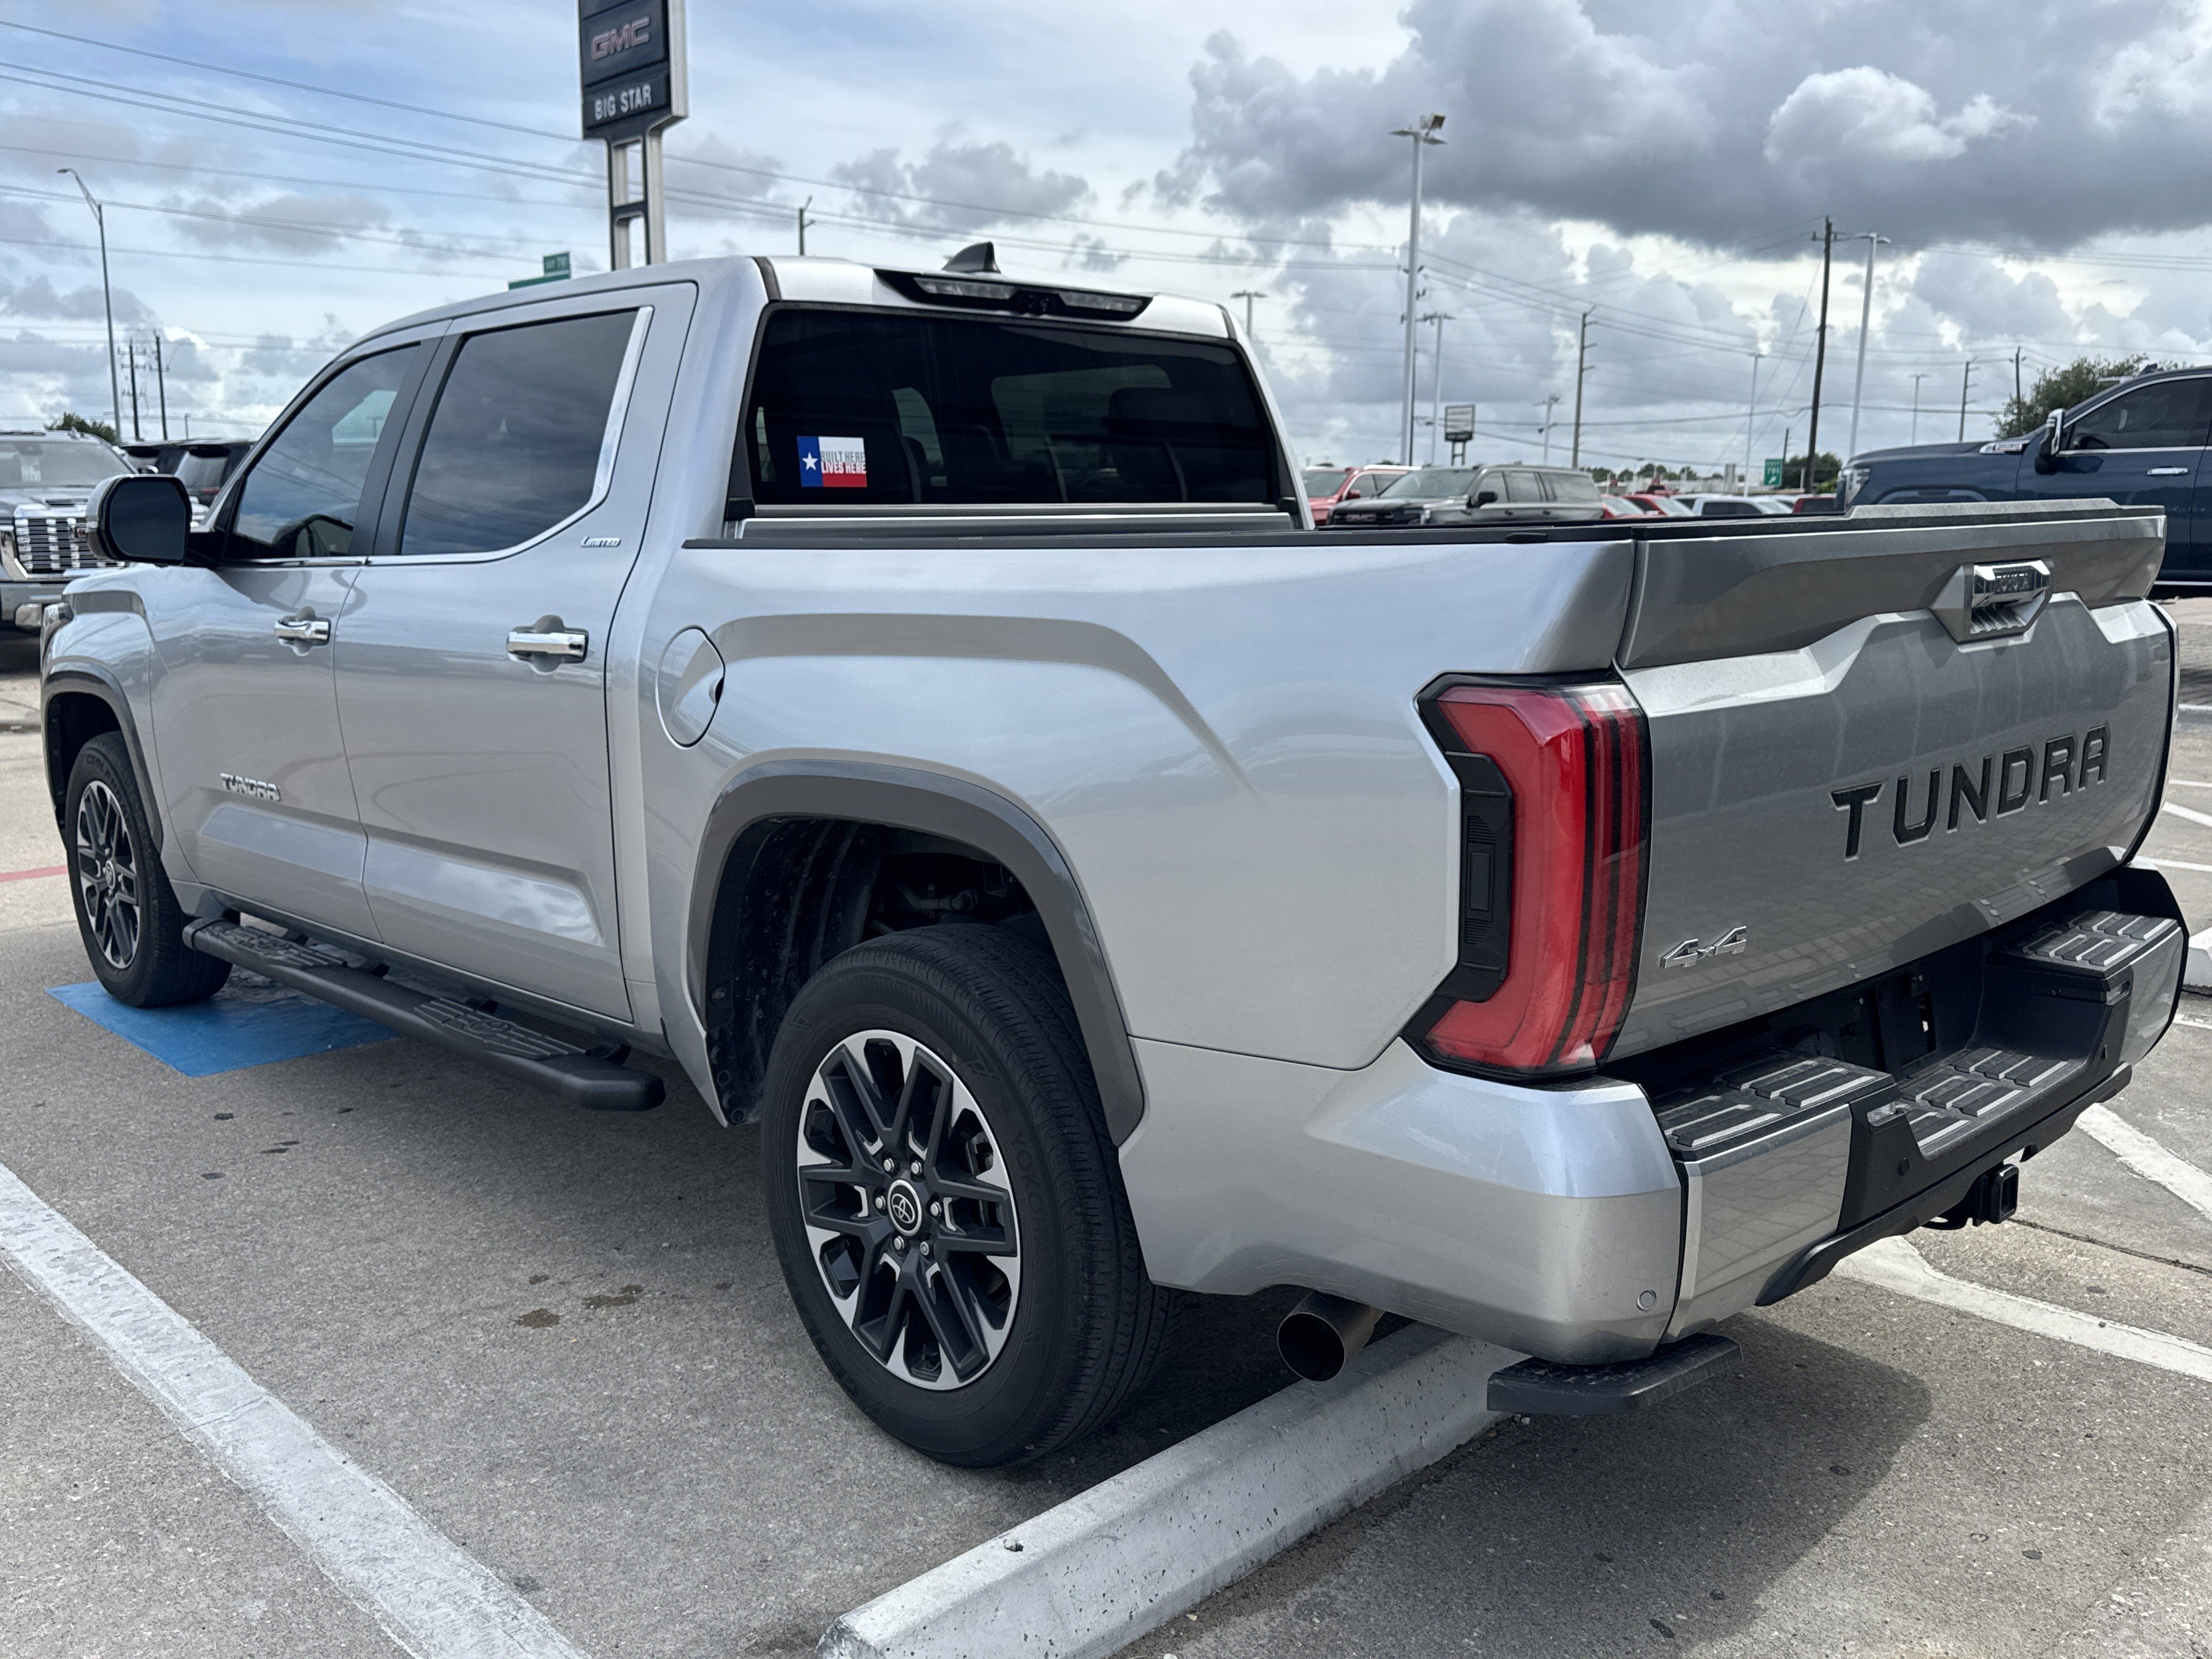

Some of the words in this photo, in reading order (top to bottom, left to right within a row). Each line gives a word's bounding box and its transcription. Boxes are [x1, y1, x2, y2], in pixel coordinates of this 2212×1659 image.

[591, 16, 651, 60] GMC
[594, 95, 616, 120] BIG
[620, 83, 652, 113] STAR
[821, 451, 843, 462] BUILT
[845, 451, 865, 462] HERE
[821, 461, 844, 474] LIVES
[845, 462, 867, 474] HERE
[220, 772, 281, 802] TUNDRA
[1830, 720, 2111, 862] TUNDRA
